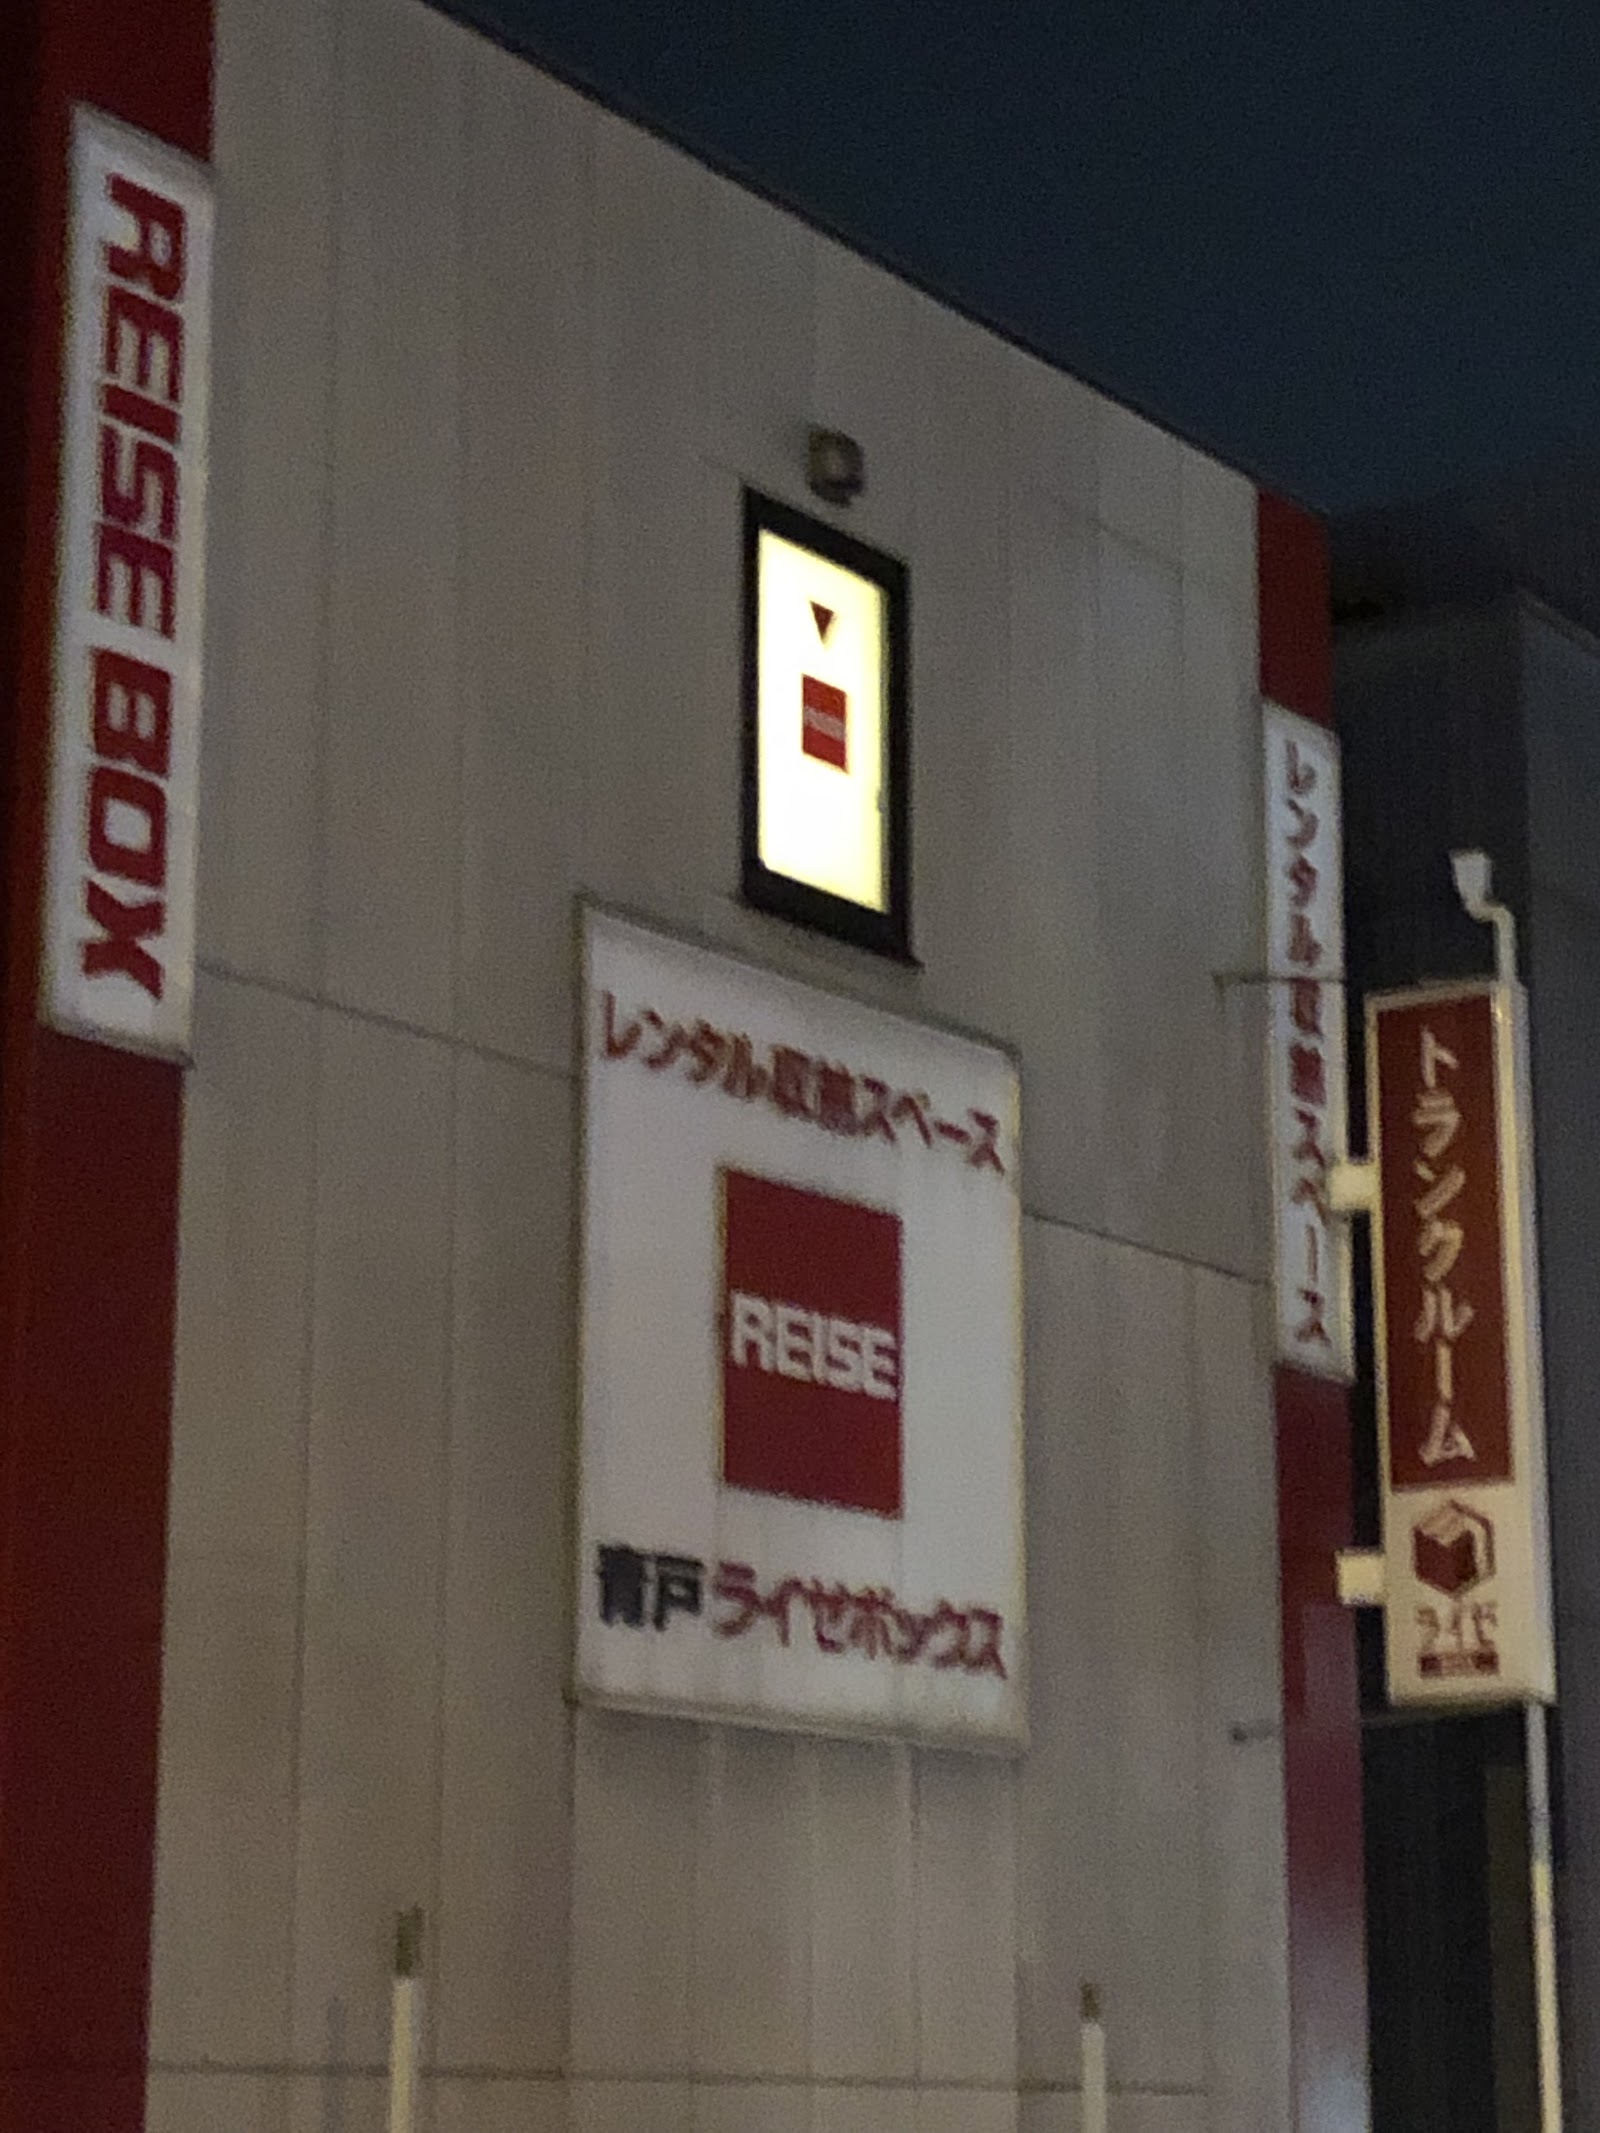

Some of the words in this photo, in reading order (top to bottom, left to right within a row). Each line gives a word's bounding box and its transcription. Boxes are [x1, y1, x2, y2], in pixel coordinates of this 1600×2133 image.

[96, 172, 187, 642] REISE
[81, 645, 173, 1002] BOX
[730, 1288, 898, 1404] REISE
[1413, 1024, 1475, 1466] トランクルーム
